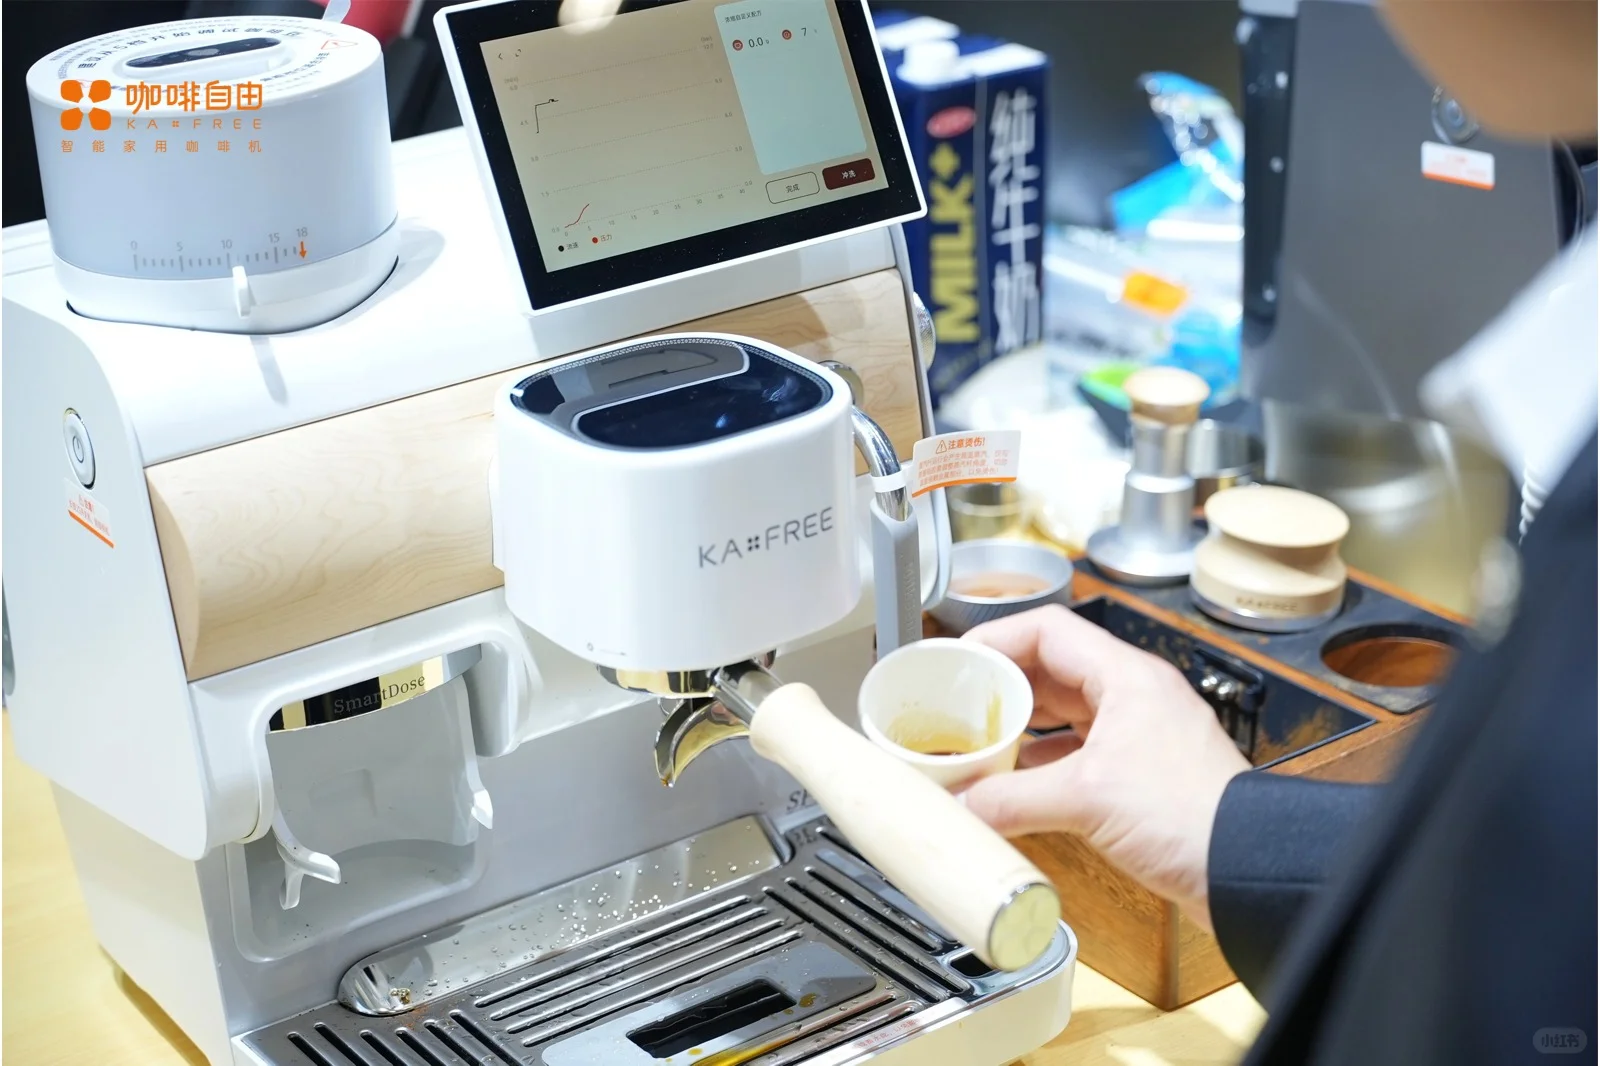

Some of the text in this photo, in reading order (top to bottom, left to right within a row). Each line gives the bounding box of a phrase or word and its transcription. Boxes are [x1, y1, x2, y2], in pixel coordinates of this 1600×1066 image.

[801, 27, 807, 37] 7
[748, 37, 764, 48] 0.0
[785, 183, 800, 194] 完成
[130, 227, 308, 251] 0 5 10 15 18
[600, 234, 612, 242] 压力
[698, 506, 833, 569] KA FREE
[334, 675, 425, 714] SmartDose
